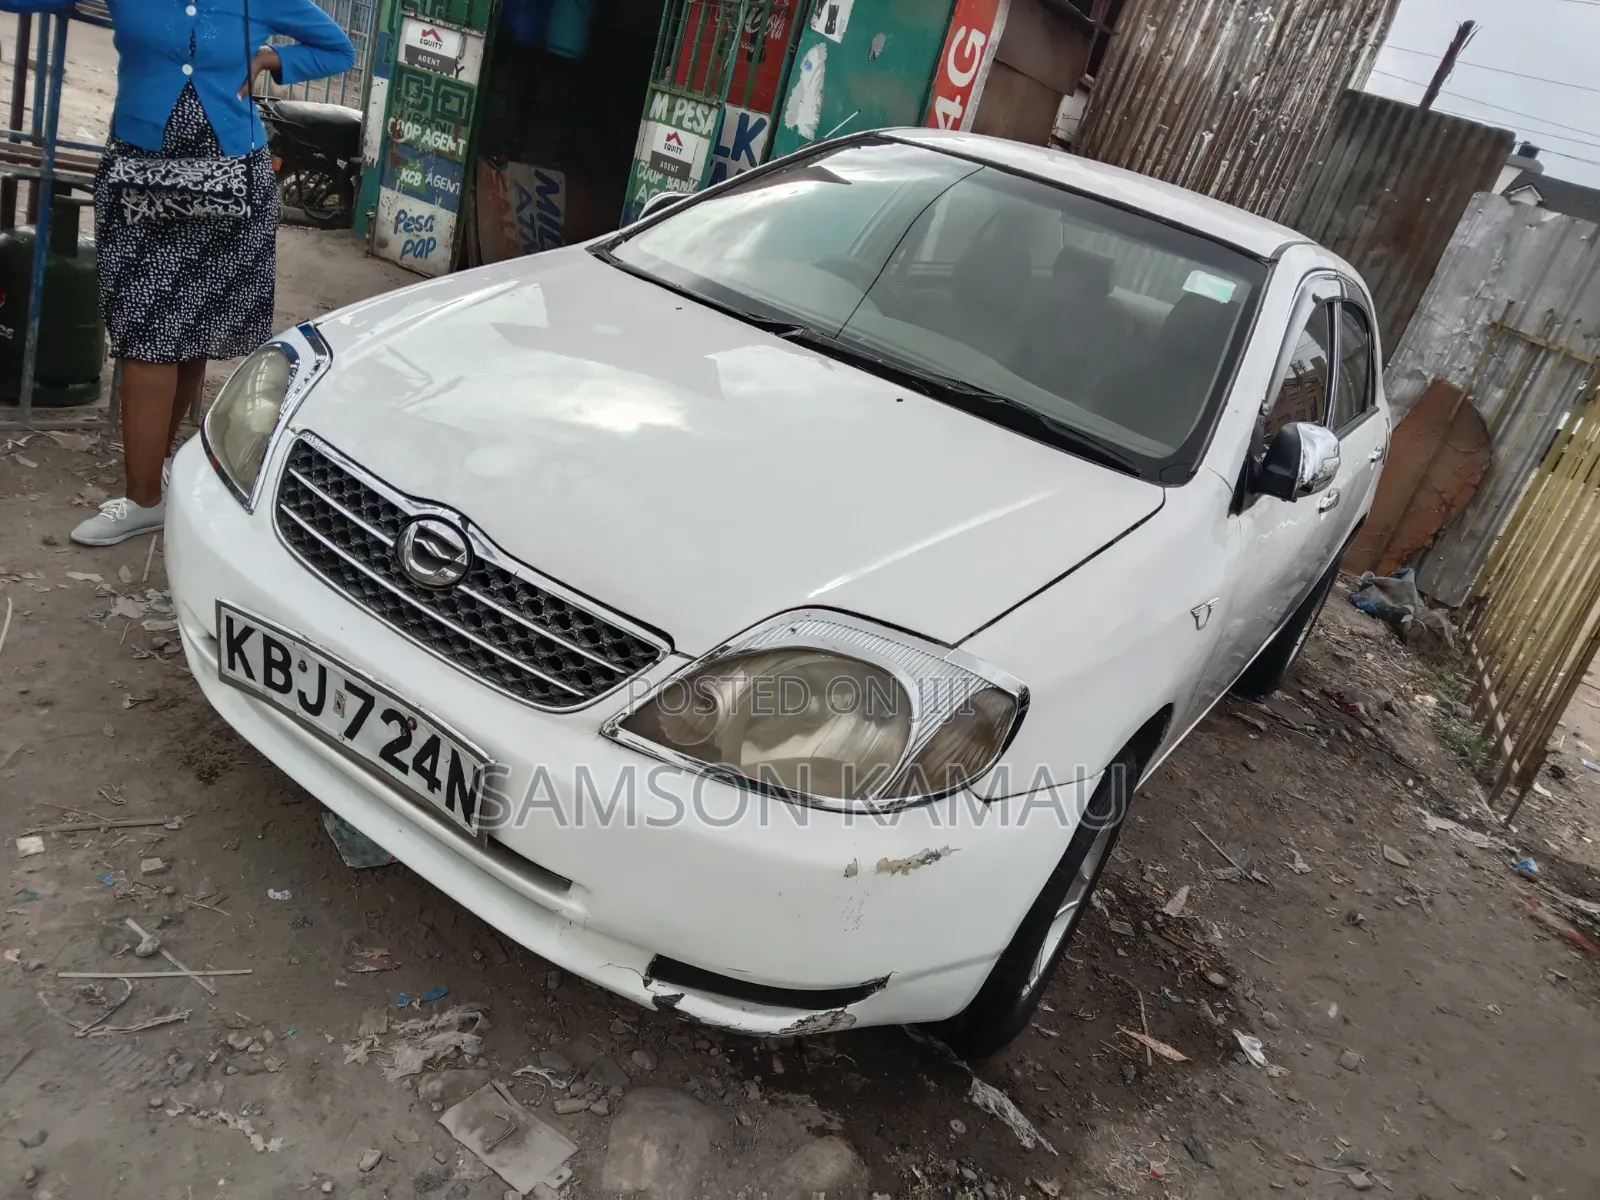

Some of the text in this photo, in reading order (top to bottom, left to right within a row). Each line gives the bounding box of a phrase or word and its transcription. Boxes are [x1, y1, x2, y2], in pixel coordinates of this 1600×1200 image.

[420, 38, 443, 50] EQUITY
[418, 54, 440, 66] AGENT
[421, 128, 466, 155] AGENT
[664, 142, 683, 155] EQUITY
[660, 161, 679, 173] AGENT
[400, 168, 460, 195] KCB AGENT
[225, 614, 482, 830] KBJ 724N
